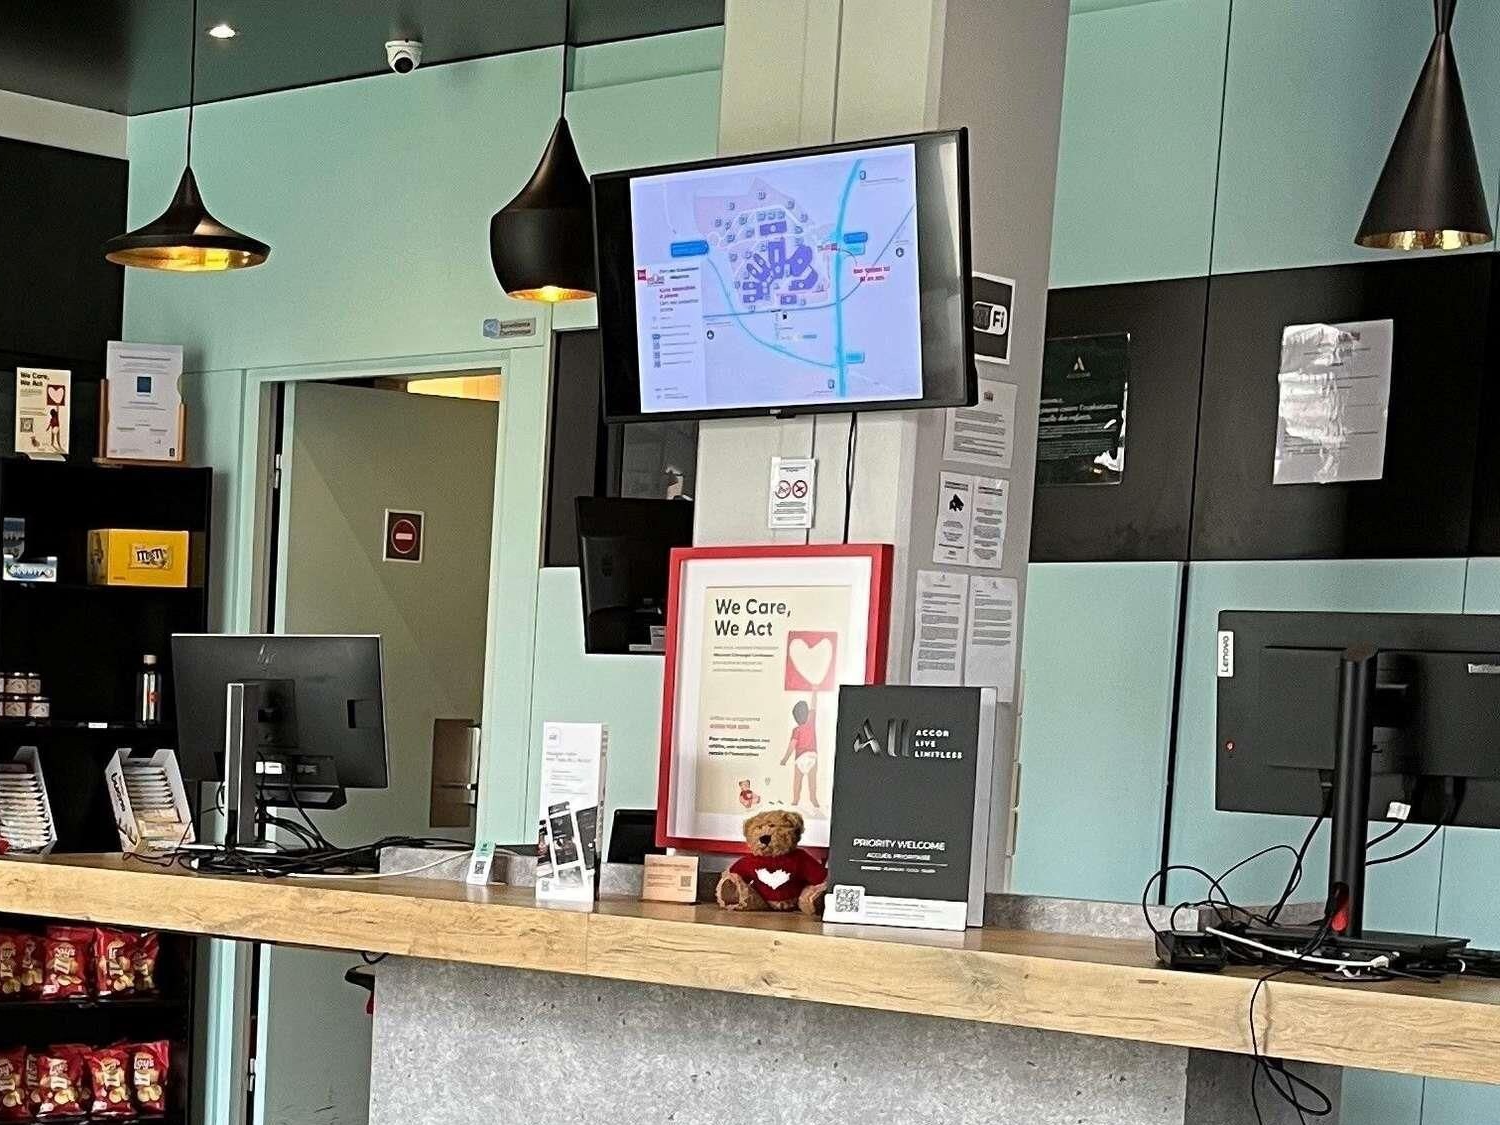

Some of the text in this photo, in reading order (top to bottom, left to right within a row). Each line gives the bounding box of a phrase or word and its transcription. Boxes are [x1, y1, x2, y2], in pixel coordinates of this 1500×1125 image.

[715, 598, 791, 618] We Care,
[714, 620, 774, 637] We Act
[1221, 635, 1229, 673] Lenovo
[916, 729, 950, 737] ACCOR
[915, 740, 936, 748] LIVE
[914, 750, 963, 759] LIMITLESS
[853, 838, 946, 851] PRIORITY WELCOME
